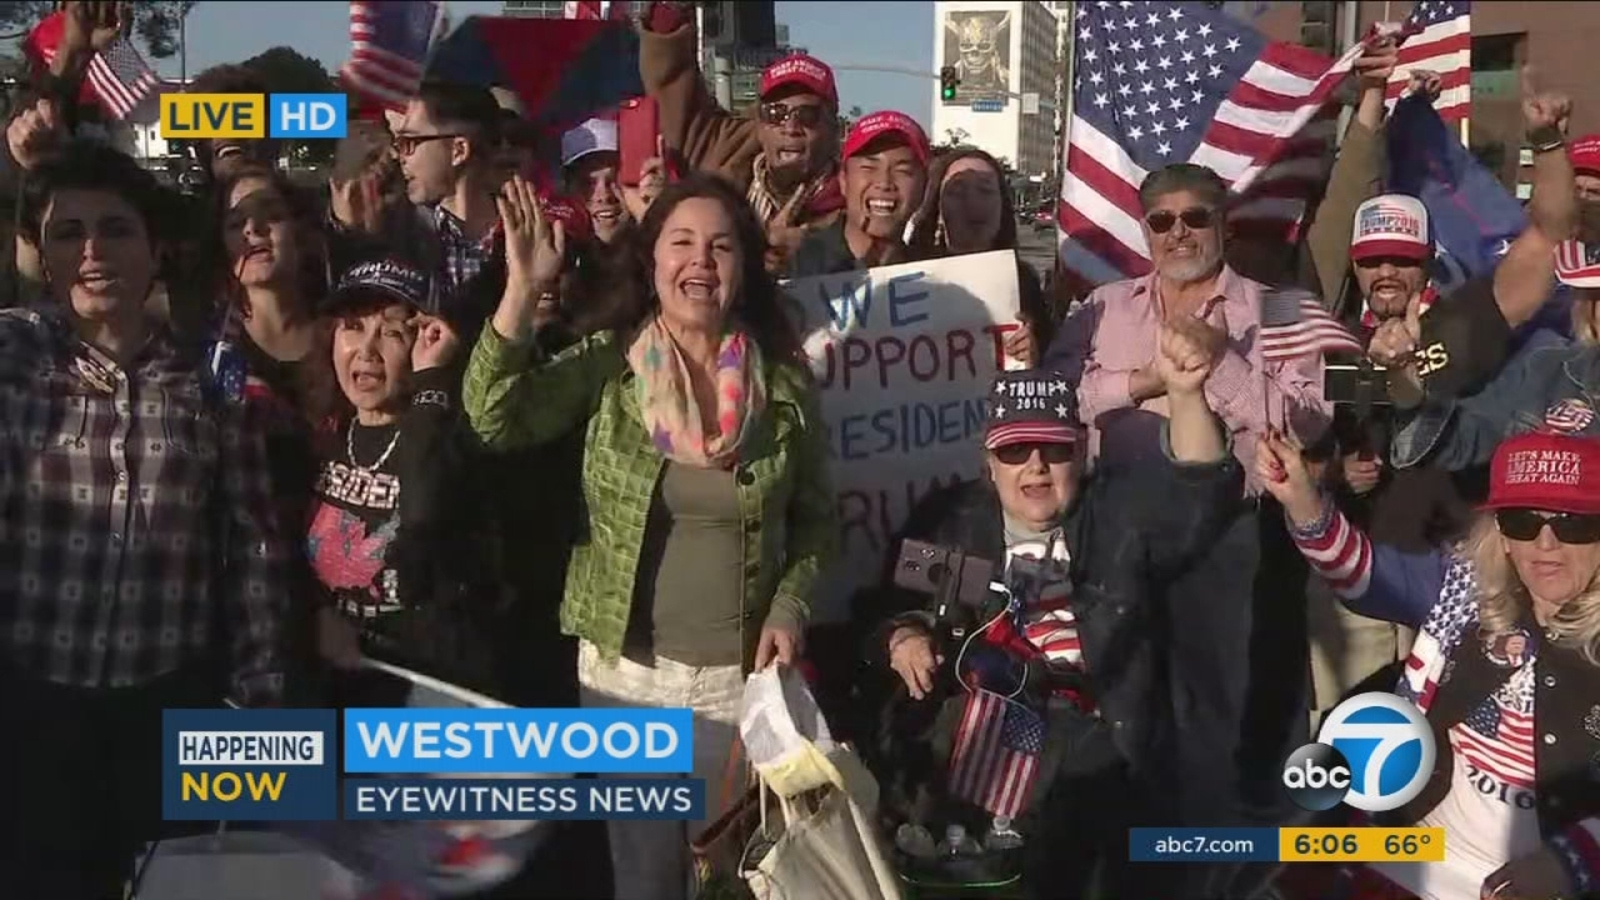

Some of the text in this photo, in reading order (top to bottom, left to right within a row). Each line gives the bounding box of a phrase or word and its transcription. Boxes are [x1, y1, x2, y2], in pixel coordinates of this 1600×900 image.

[819, 271, 929, 332] WE
[803, 324, 1020, 391] UPPORT
[1009, 381, 1056, 397] TRUMP
[1016, 398, 1046, 410] 2016
[829, 398, 988, 461] ESIDEN
[1541, 450, 1581, 463] MAKE
[1539, 474, 1580, 486] AGAIN
[1467, 765, 1536, 810] 2016
